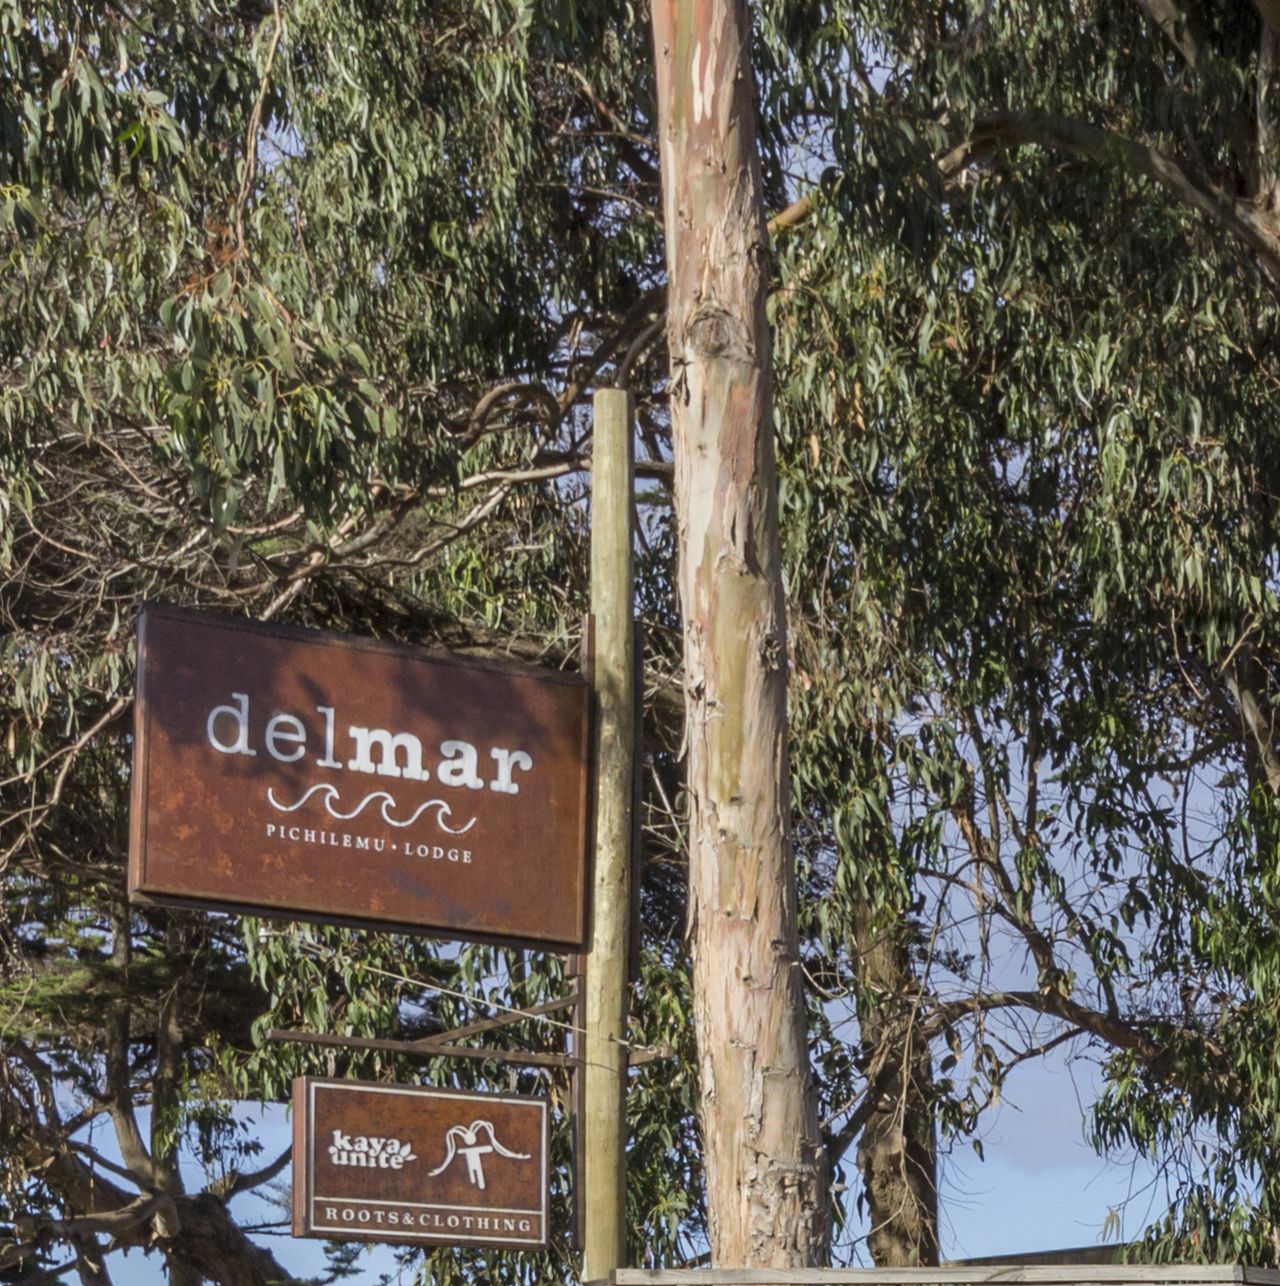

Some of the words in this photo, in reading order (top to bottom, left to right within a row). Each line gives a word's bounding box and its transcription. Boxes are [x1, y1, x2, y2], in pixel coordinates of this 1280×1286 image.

[206, 692, 533, 795] delmar
[266, 823, 386, 852] PICHILEMU
[404, 842, 473, 863] LODGE
[328, 1145, 405, 1169] unite
[332, 1129, 401, 1157] kaya
